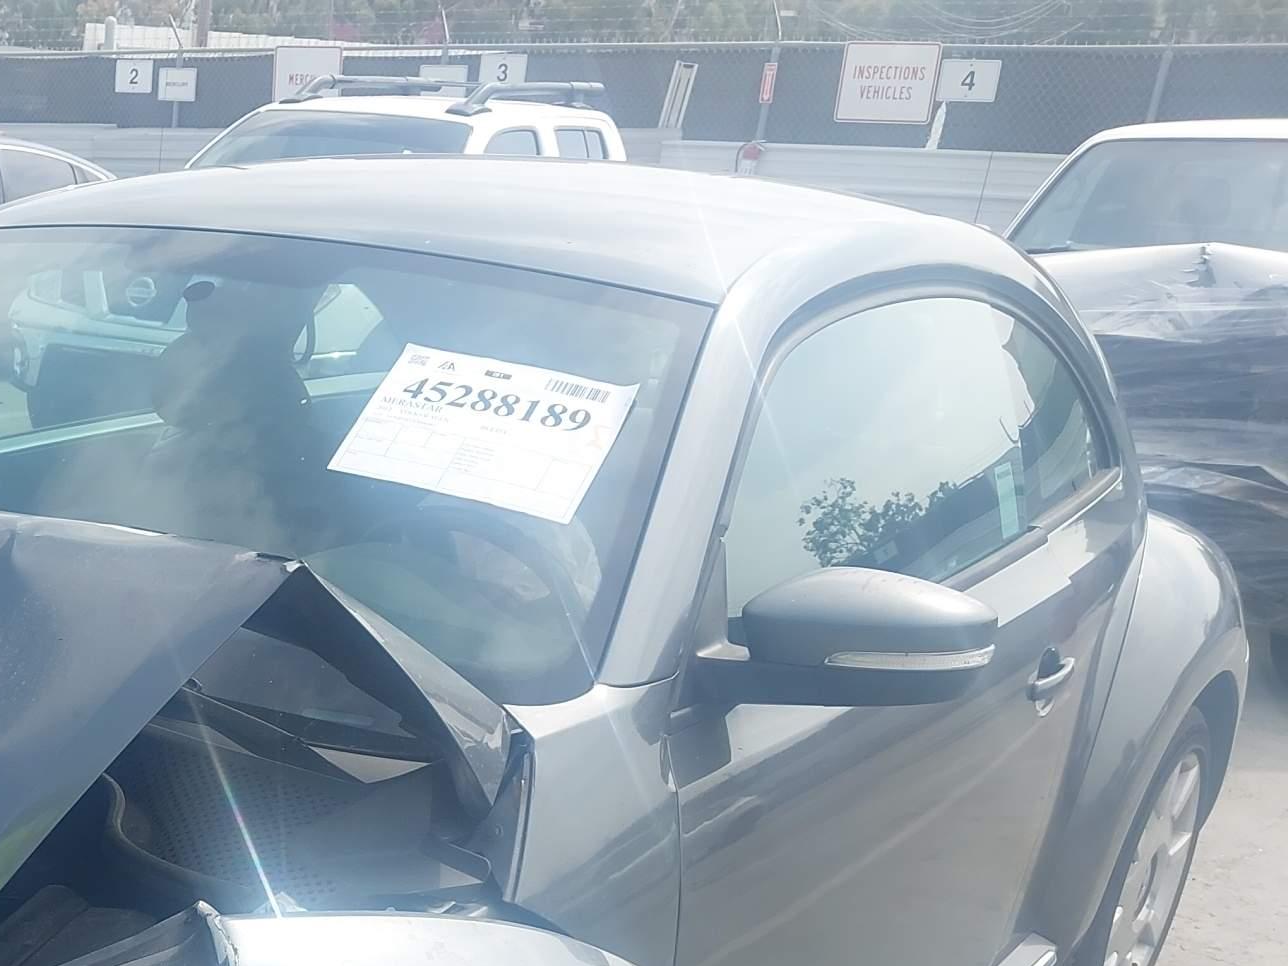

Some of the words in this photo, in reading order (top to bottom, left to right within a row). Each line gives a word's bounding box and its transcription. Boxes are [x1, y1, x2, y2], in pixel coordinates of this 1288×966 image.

[129, 68, 139, 85] 2
[497, 64, 508, 82] 3
[852, 65, 926, 81] INSPECTIONS
[960, 71, 976, 91] 4
[859, 85, 913, 100] VEHICLES
[402, 377, 592, 432] 45288189
